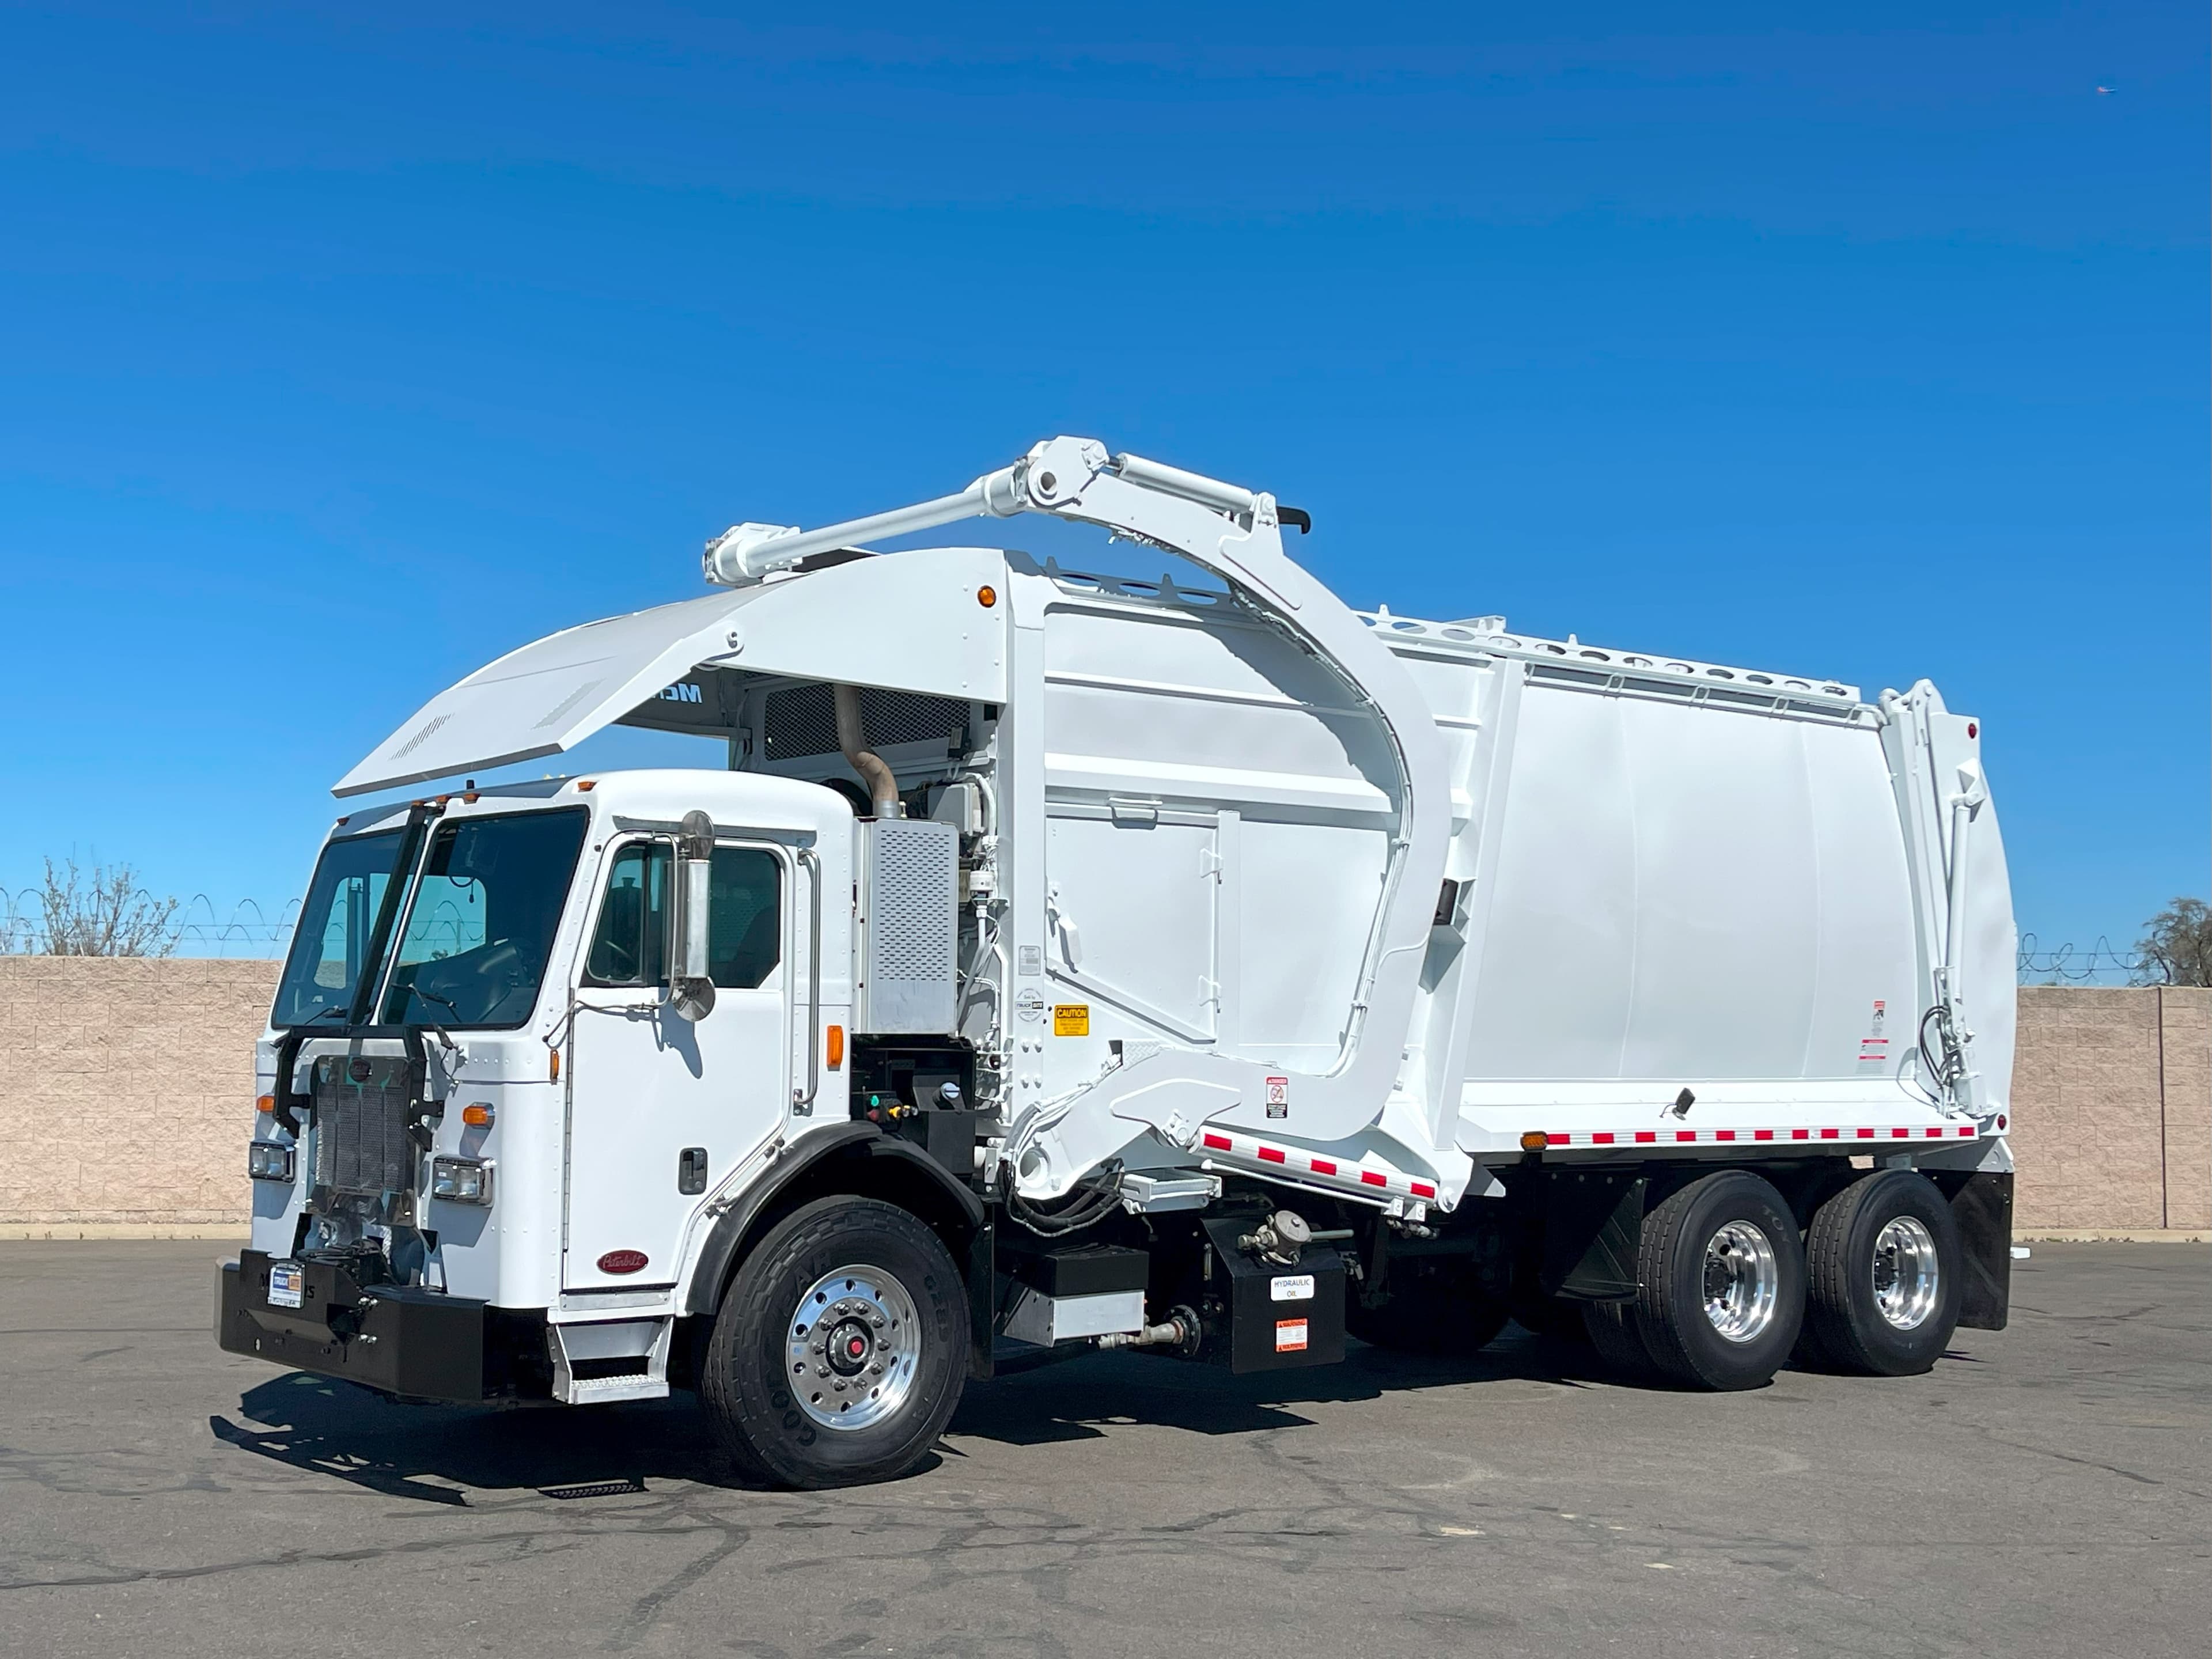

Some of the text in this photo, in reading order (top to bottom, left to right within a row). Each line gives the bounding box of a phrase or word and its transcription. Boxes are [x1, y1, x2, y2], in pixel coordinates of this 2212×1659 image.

[1057, 1009, 1086, 1017] CAUTION
[603, 1254, 645, 1268] Peterbilt
[1274, 1279, 1310, 1287] HYDRAULIC
